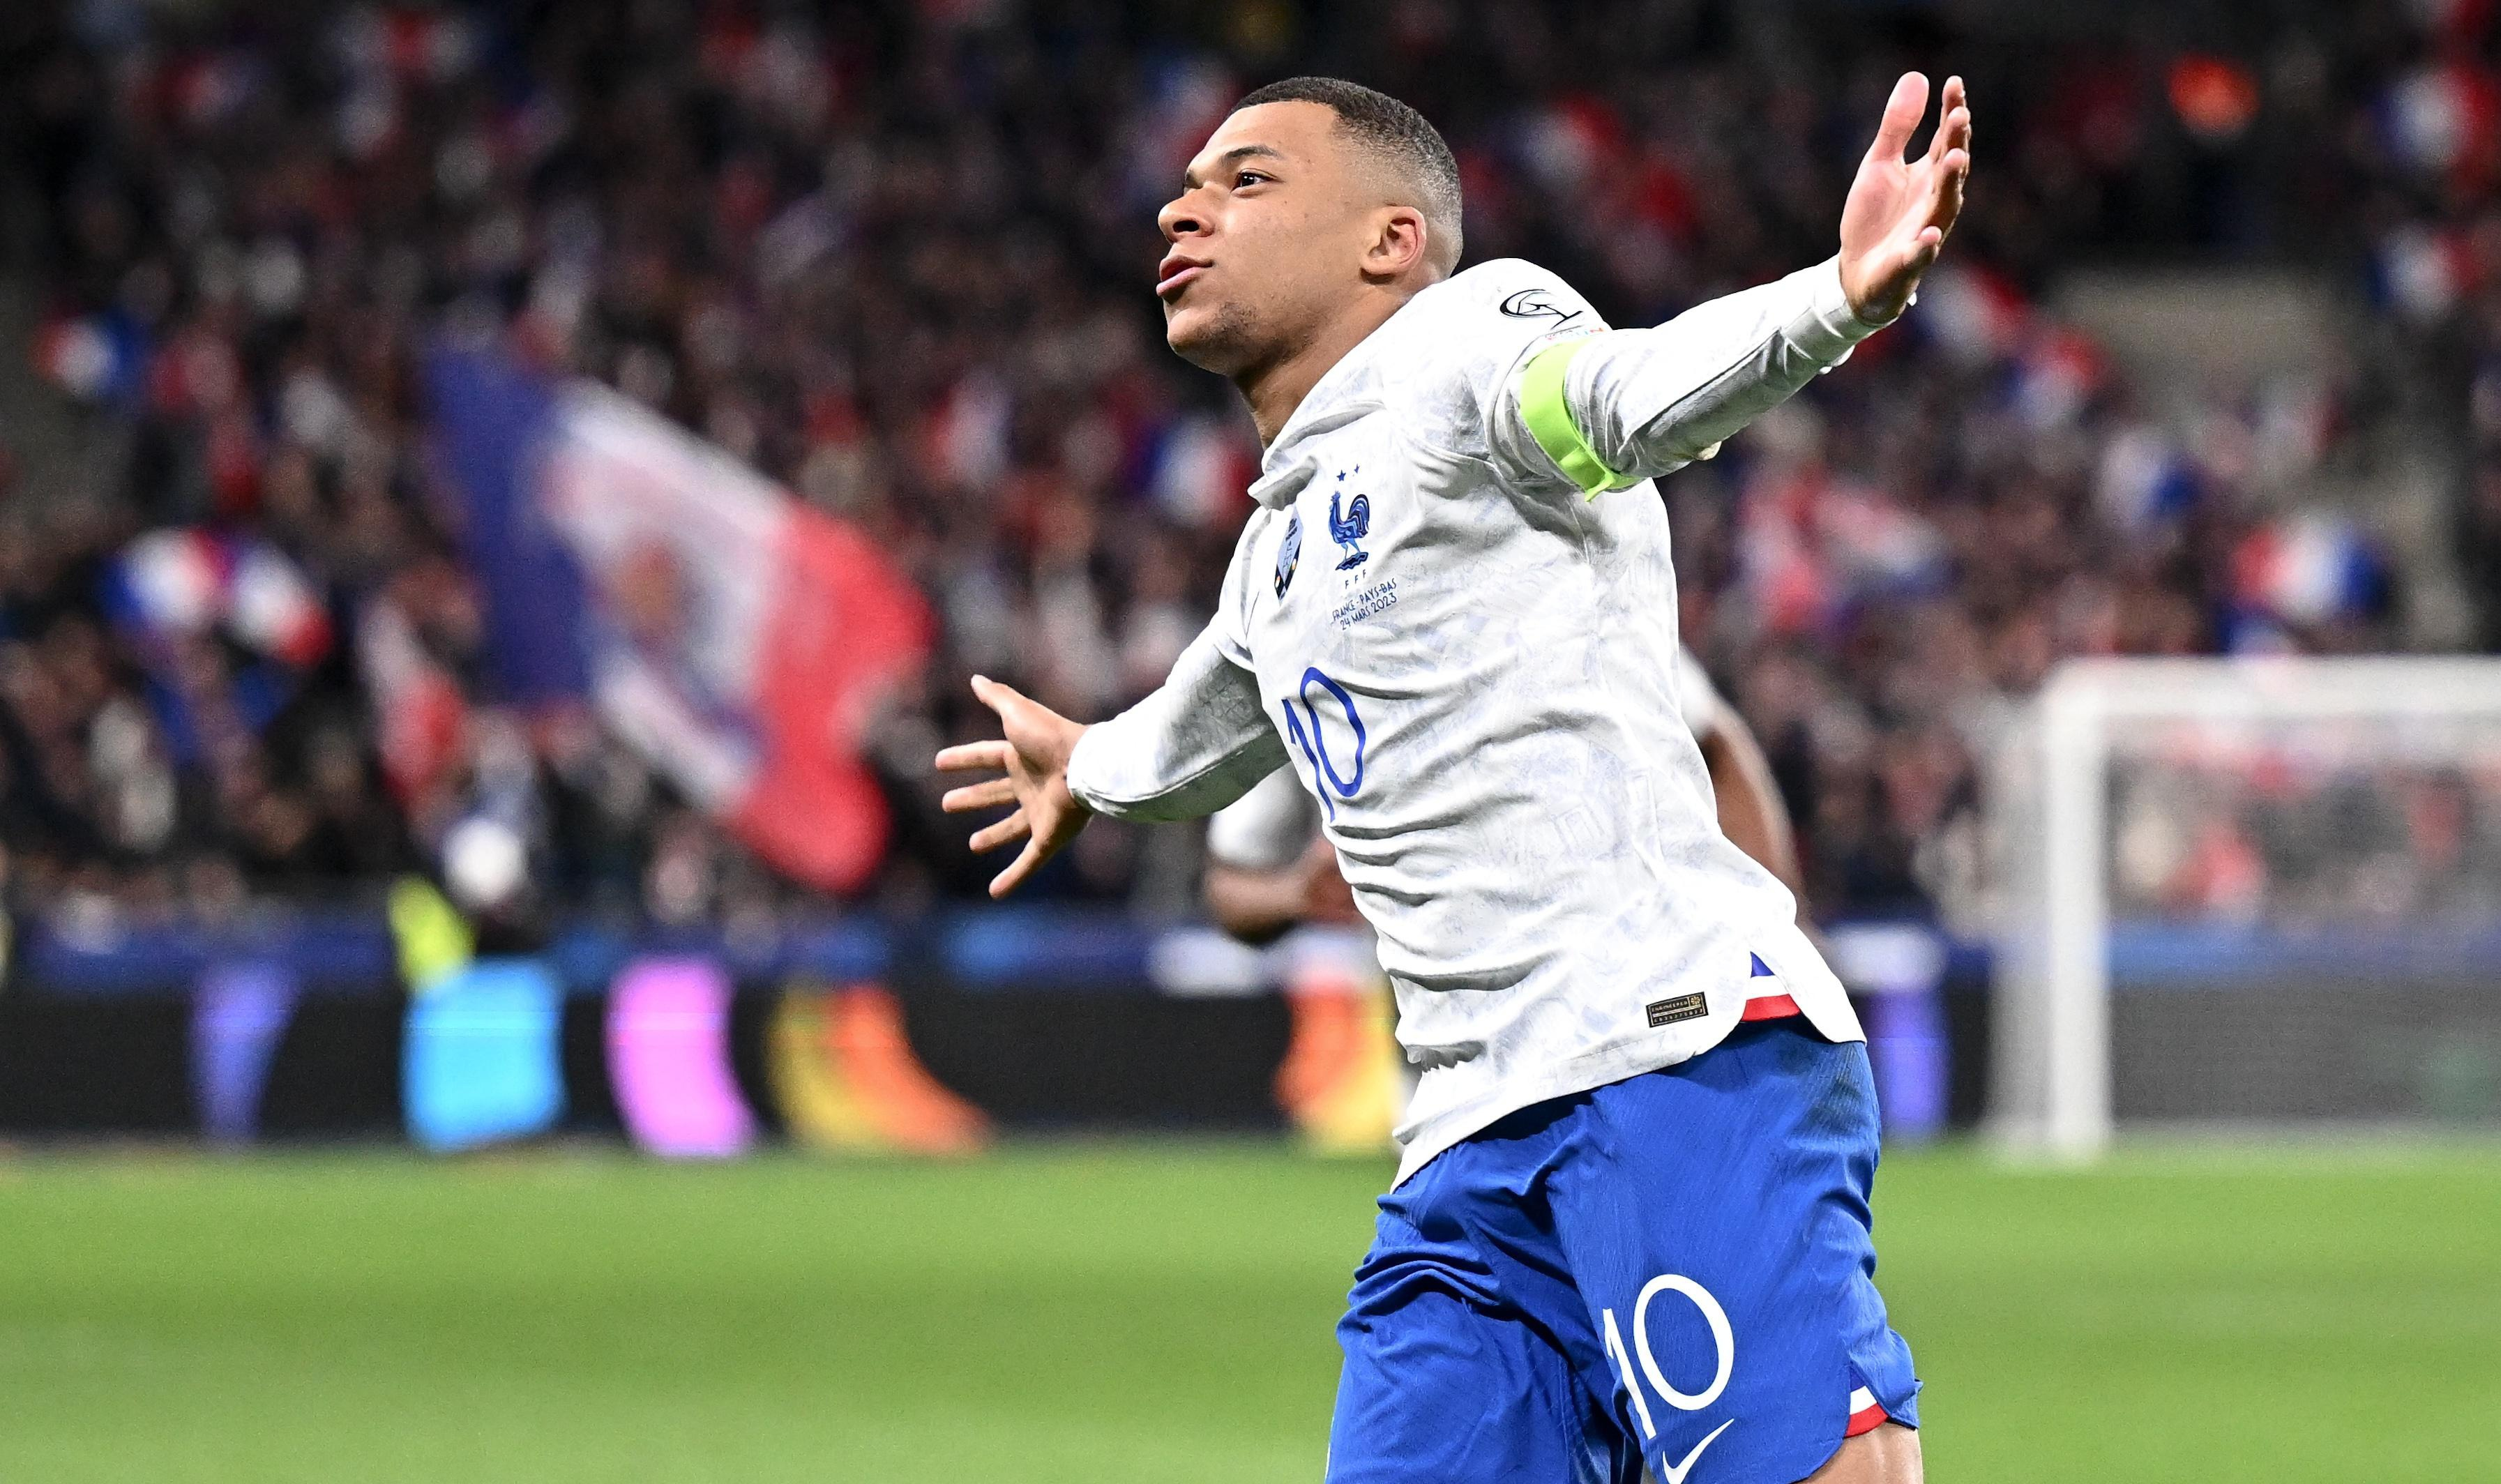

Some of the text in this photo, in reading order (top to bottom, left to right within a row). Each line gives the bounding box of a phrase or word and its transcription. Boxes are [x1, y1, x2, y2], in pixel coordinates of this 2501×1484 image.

[1332, 599, 1356, 621] FRANCE
[1340, 592, 1397, 630] 24 MARS 2023
[1281, 667, 1366, 823] 10
[1603, 1273, 1735, 1440] 10
